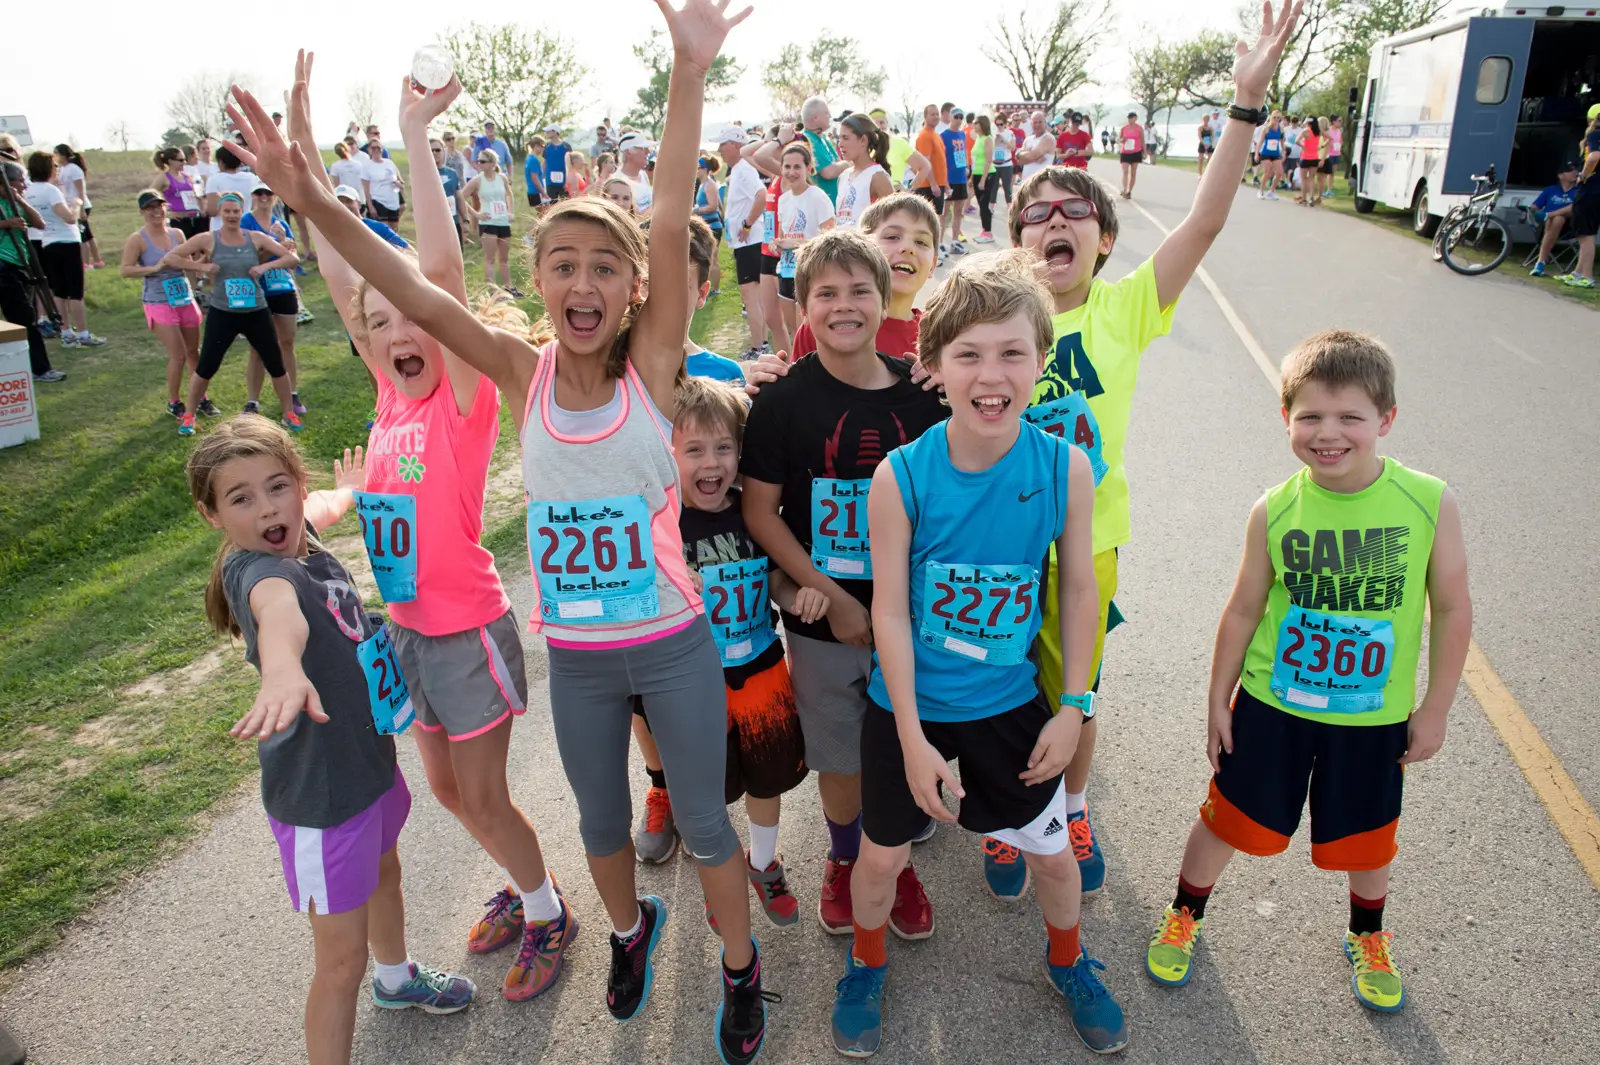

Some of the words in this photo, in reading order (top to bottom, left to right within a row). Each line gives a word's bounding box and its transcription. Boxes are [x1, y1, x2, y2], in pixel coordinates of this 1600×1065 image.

[228, 284, 254, 296] 2262
[832, 483, 869, 497] luk
[356, 496, 395, 512] ke's
[548, 505, 625, 523] luke's
[819, 499, 870, 538] 21
[538, 521, 647, 575] 2261
[1281, 526, 1410, 576] GAME
[556, 576, 630, 592] locker
[949, 569, 1022, 584] luke's
[1284, 571, 1406, 612] MAKER
[931, 582, 1033, 627] 2275
[944, 620, 1015, 640] locker
[1300, 613, 1372, 637] luke's
[1282, 626, 1387, 678] 2360
[1293, 670, 1363, 690] locker
